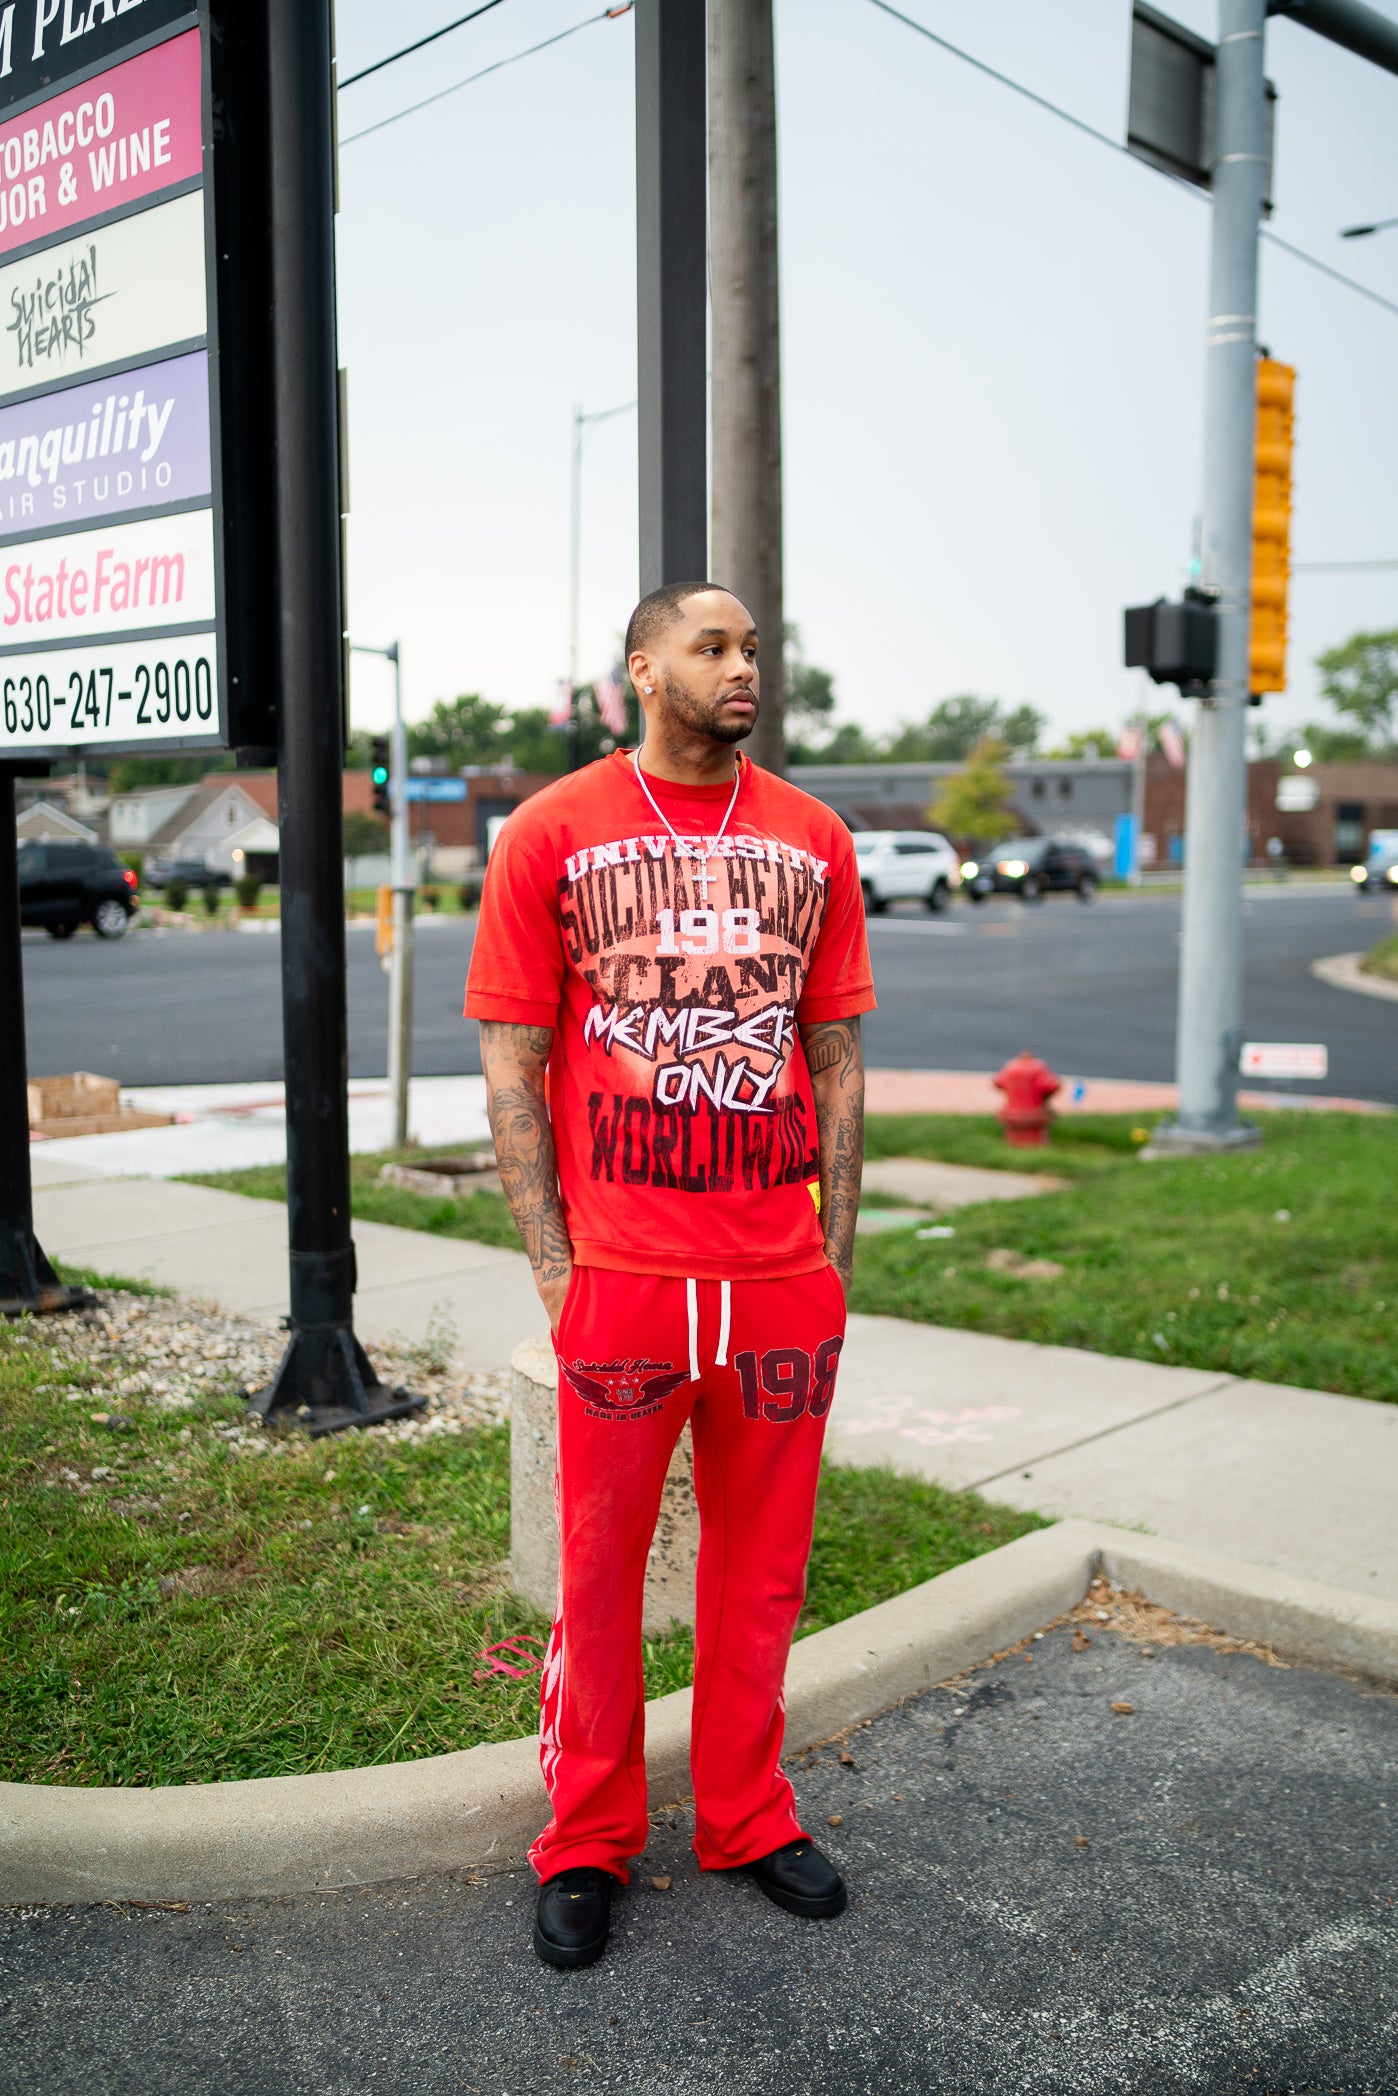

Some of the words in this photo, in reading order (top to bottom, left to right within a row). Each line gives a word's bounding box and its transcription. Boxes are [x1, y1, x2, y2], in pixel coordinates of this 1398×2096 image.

[0, 92, 115, 183] OBACCO
[57, 161, 79, 206] &
[88, 118, 172, 193] WINE
[53, 461, 172, 509] STUDIO
[3, 656, 212, 734] 630-247-2900
[564, 835, 829, 885] UNIVERSITY
[655, 907, 761, 955] 198
[655, 1054, 784, 1112] ONLY
